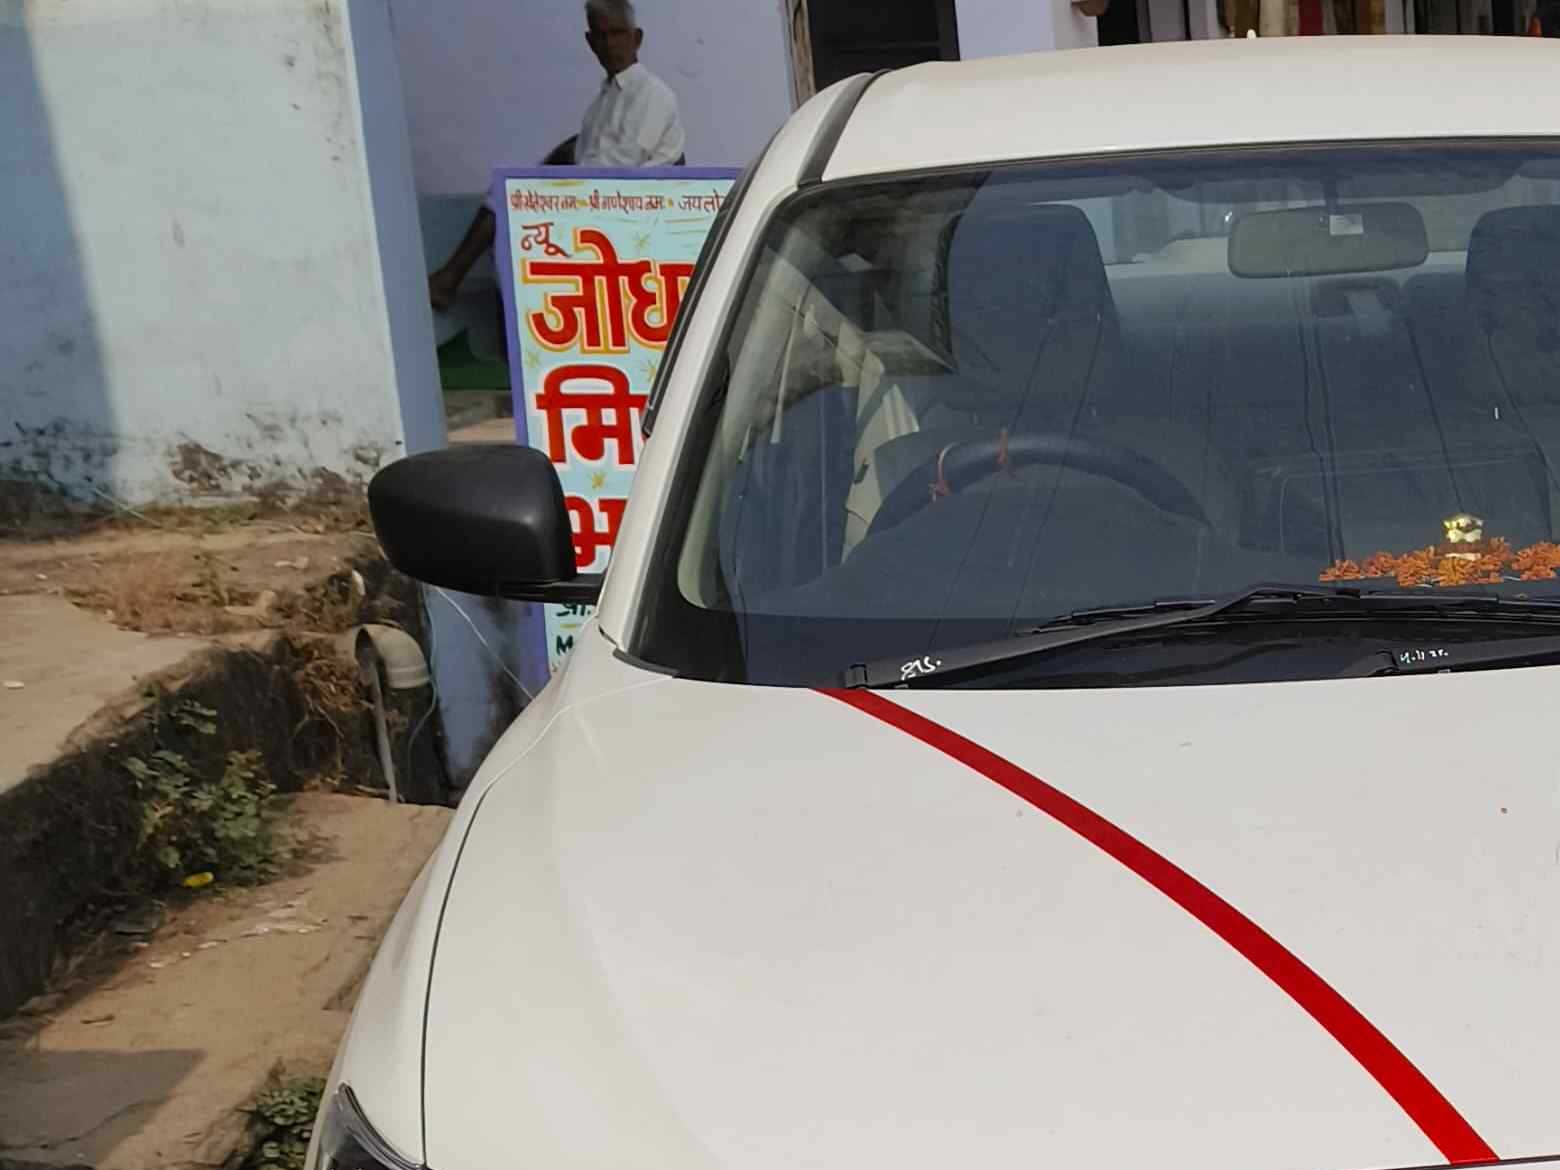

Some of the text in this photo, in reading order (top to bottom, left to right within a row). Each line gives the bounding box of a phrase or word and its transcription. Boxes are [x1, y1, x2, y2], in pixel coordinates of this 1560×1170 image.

[521, 222, 571, 258] न्यू
[524, 228, 698, 352] जोध
[536, 365, 650, 464] मि
[565, 495, 629, 567] भ
